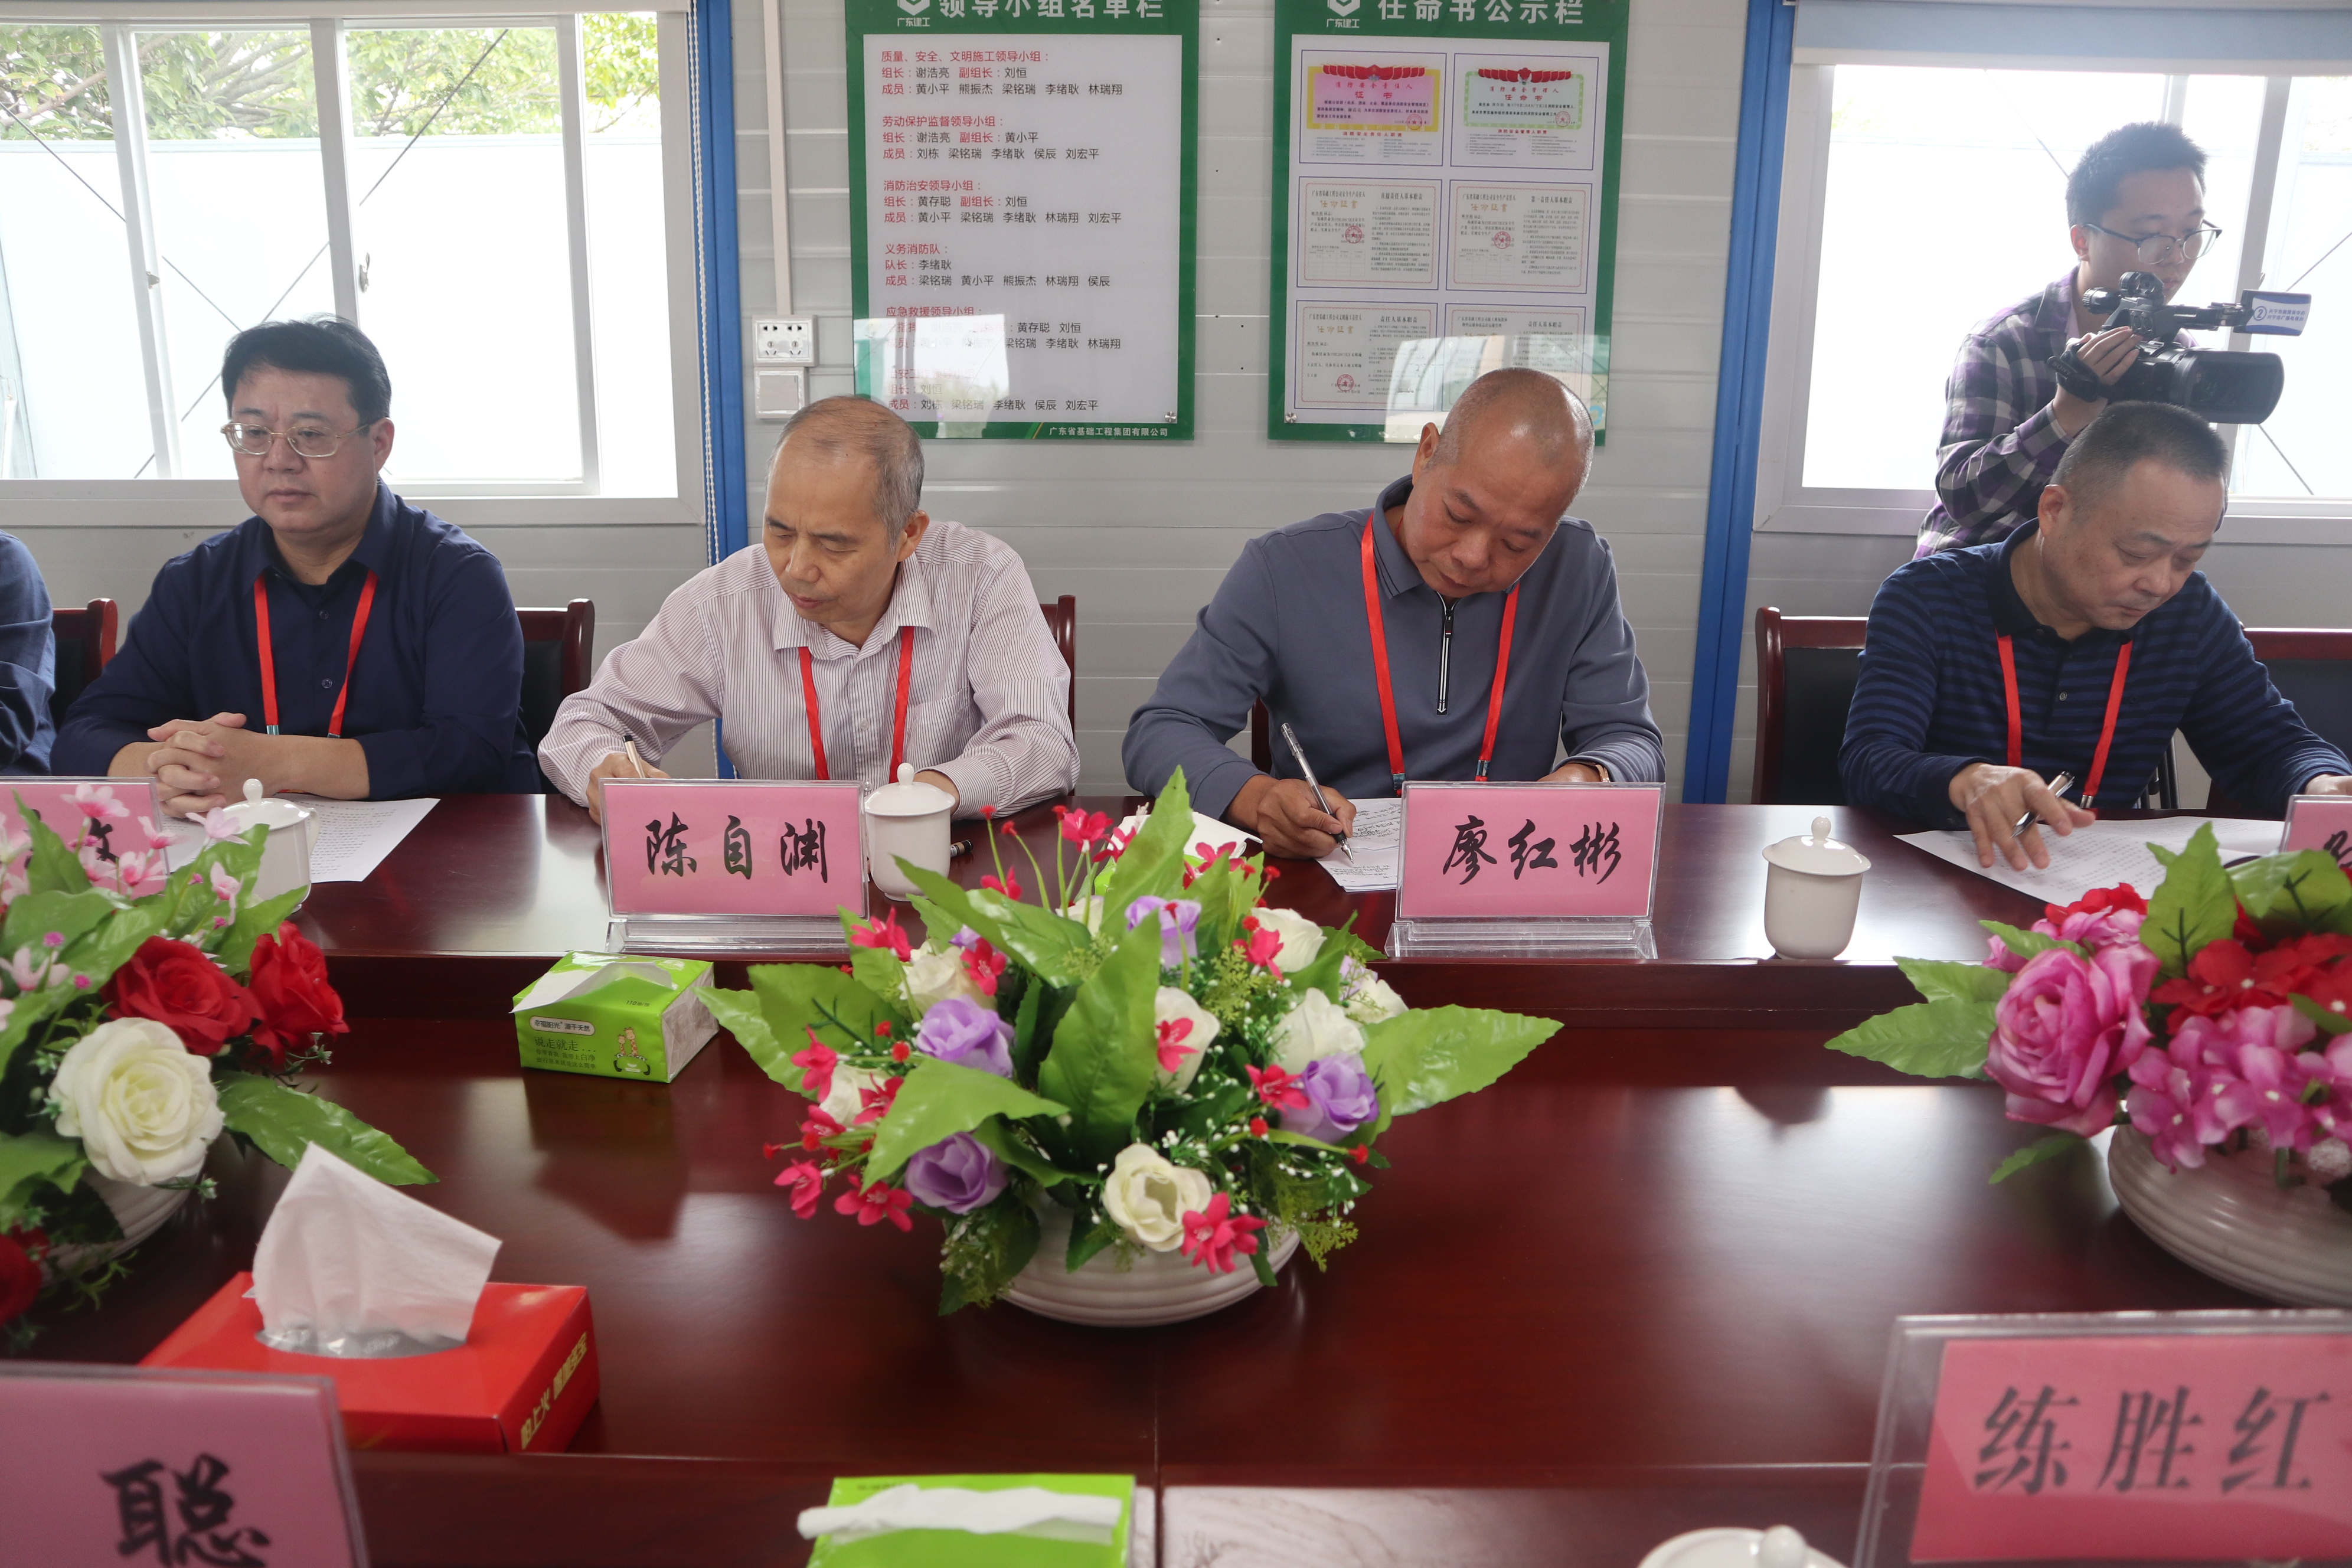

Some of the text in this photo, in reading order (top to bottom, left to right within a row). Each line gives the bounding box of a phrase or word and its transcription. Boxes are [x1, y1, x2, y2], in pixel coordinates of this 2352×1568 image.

[940, 0, 1164, 19] 领导小组名单栏
[1377, 0, 1584, 25] 任命书公示栏
[897, 18, 930, 27] 广东建工
[1326, 18, 1360, 28] 广东建工
[881, 51, 1047, 62] 质量、安全、文明施工领导小组：
[882, 67, 1027, 78] 组长：谢浩亮 副组长：刘恒
[882, 83, 1122, 94] 成员：黄小平 熊振杰 梁铭瑞 李绪耿 林瑞翔
[883, 116, 1002, 127] 劳动保护监督领导小组：
[883, 132, 1038, 143] 组长：谢浩亮 副组长：黄小平
[883, 148, 1099, 159] 成员：刘栋 梁铭瑞 李绪耿 侯辰 刘宏平
[884, 180, 980, 191] 消防治安领导小组：
[884, 196, 1027, 207] 组长：黄存聪 副组长：刘恒
[884, 212, 1121, 223] 成员：黄小平 梁铭瑞 李绪耿 林瑞翔 刘宏平
[886, 244, 947, 254] 义务消防队：
[886, 259, 951, 270] 队长：李绪耿
[886, 275, 1110, 286] 成员：梁铭瑞 黄小平 熊振杰 林瑞翔 侯辰
[886, 306, 981, 316] 应急救援领导小组：
[1059, 322, 1082, 334] 刘恒
[1005, 338, 1036, 348] 梁铭瑞
[1046, 338, 1079, 348] 李绪耿
[1088, 338, 1121, 348] 林瑞翔
[994, 400, 1025, 410] 李绪耿
[1035, 400, 1057, 410] 侯辰
[1066, 400, 1098, 410] 刘宏平
[1049, 427, 1168, 436] 广东省基础工程集团有限公司
[645, 811, 828, 883] 陈自渊
[1443, 815, 1622, 885] 廖红彬
[1972, 1384, 2331, 1495] 练胜红
[99, 1453, 272, 1568] 聪
